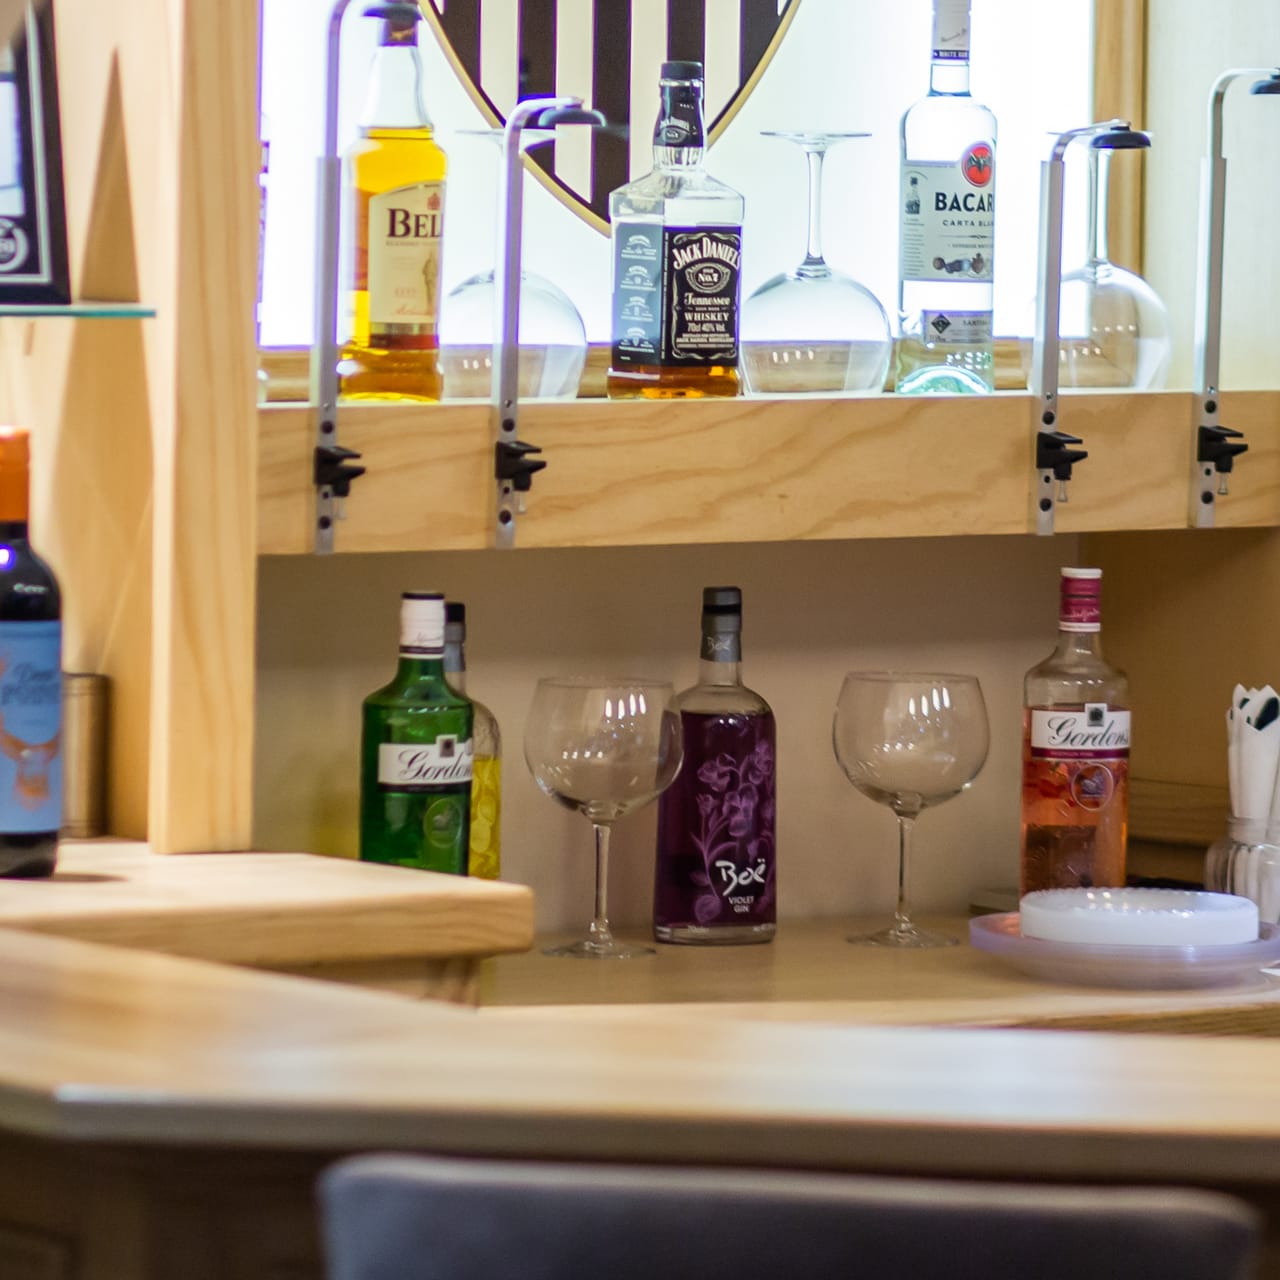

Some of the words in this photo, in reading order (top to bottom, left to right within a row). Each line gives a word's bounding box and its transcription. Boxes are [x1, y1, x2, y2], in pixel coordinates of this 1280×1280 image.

[942, 218, 975, 228] CARTA
[672, 241, 702, 270] JACK
[683, 292, 730, 306] Tennessee
[684, 311, 730, 322] WHISKEY
[728, 896, 754, 905] VIOLET
[733, 905, 750, 914] GIN
